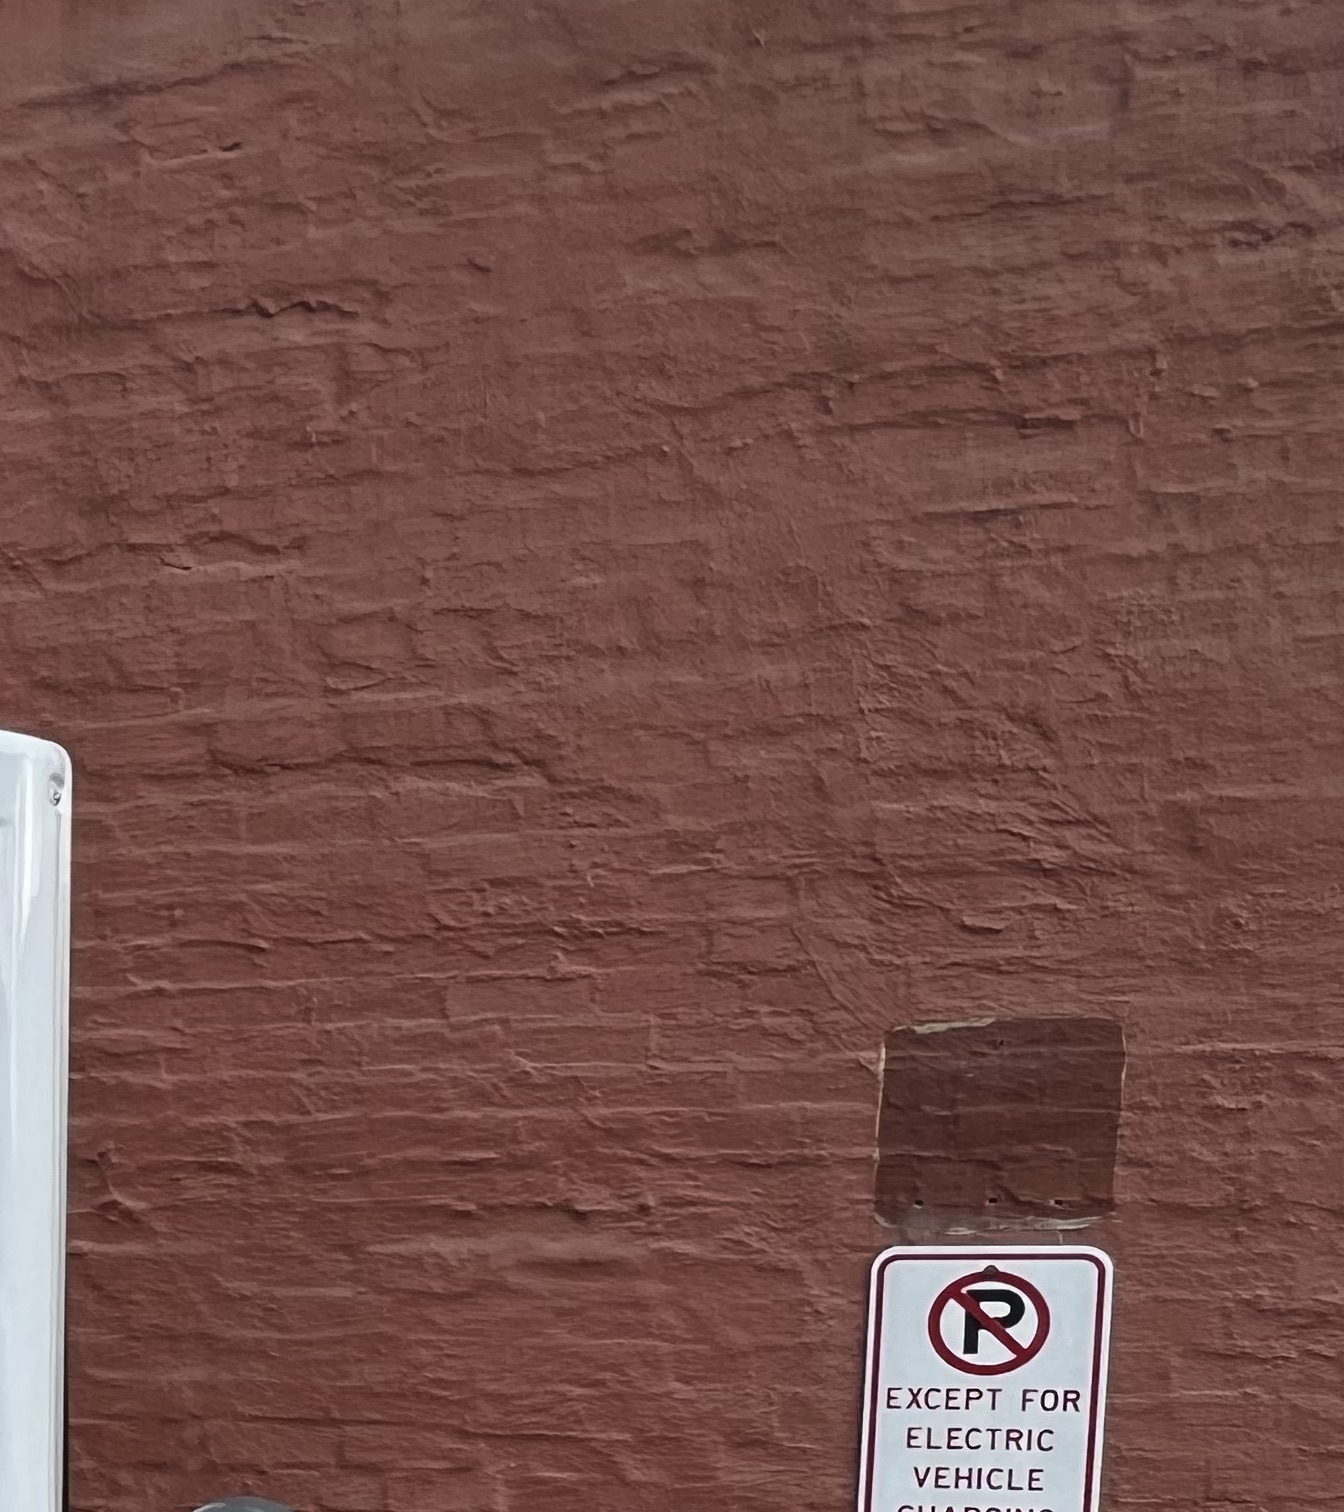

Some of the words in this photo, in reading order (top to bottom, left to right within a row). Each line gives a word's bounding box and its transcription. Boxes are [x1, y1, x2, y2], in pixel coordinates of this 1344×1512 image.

[885, 1387, 1003, 1411] EXCEPT
[1020, 1389, 1082, 1413] FOR
[905, 1427, 1056, 1452] ELECTRIC
[912, 1466, 1045, 1492] VEHICLE
